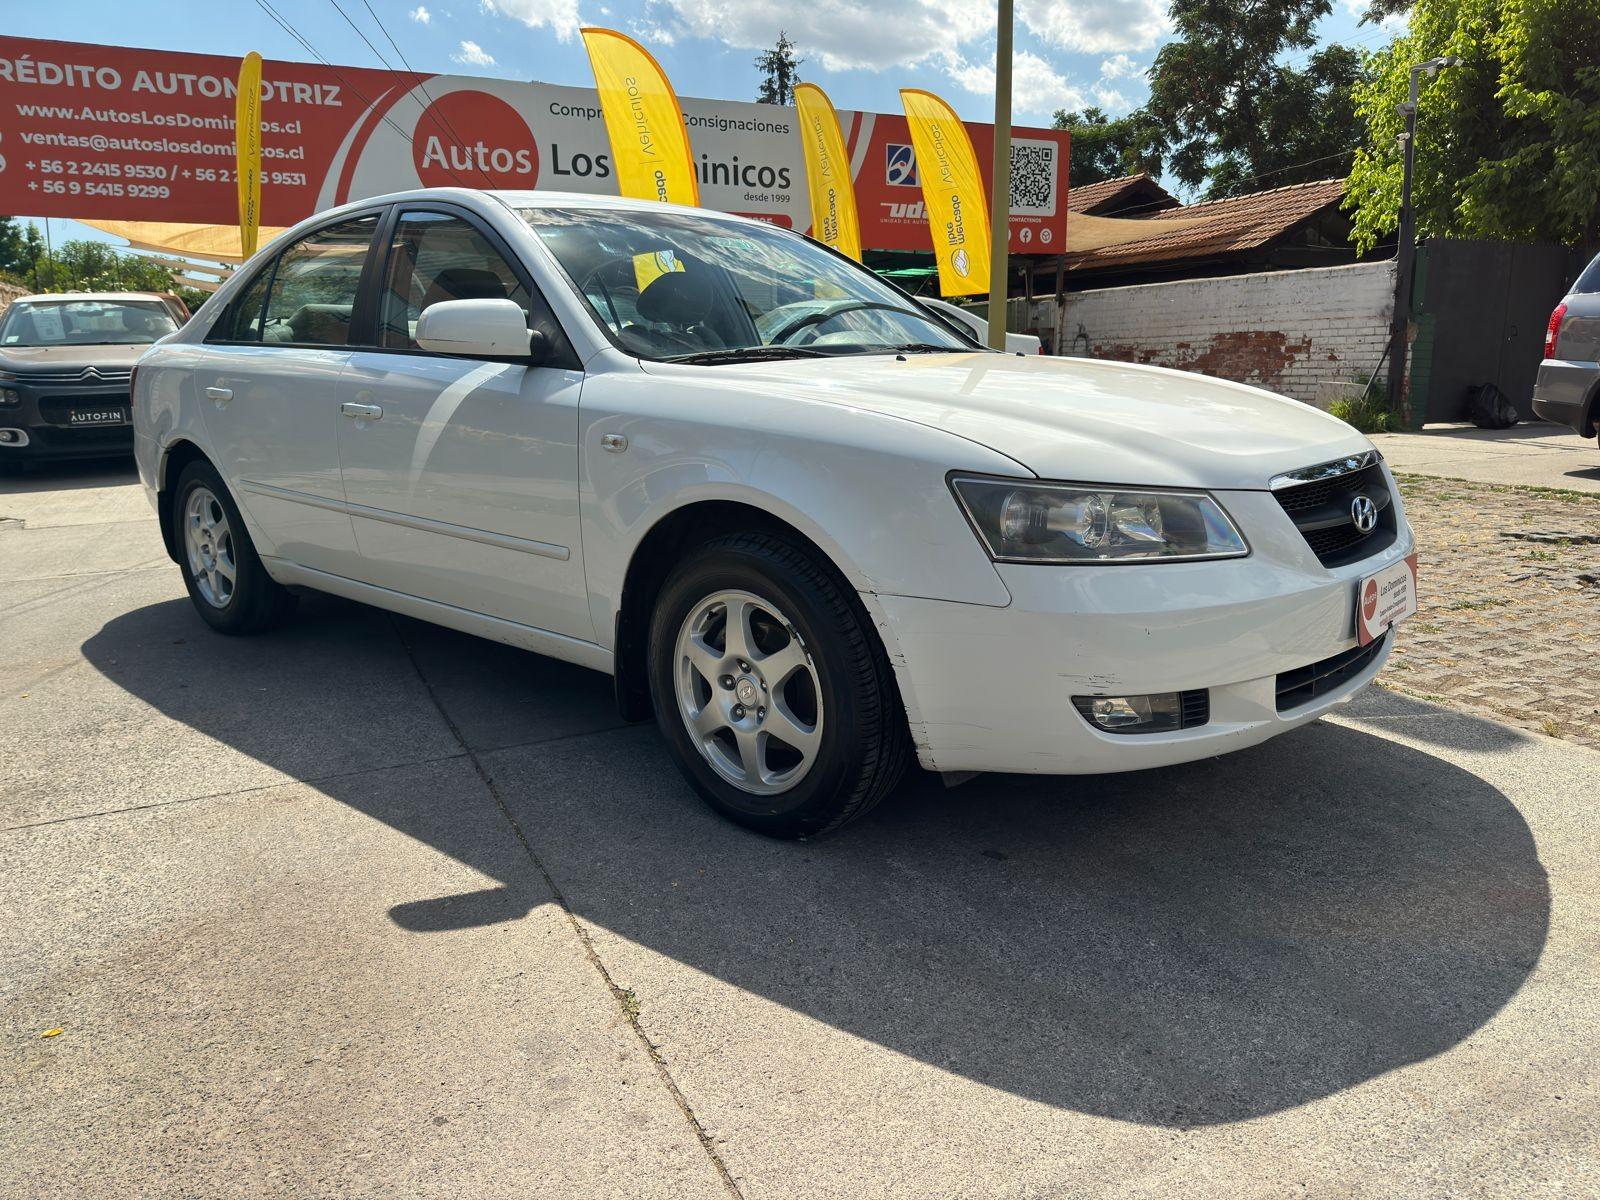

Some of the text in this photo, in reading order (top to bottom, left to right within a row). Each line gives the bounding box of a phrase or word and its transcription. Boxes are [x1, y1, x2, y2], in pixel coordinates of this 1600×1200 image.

[0, 54, 122, 90] RÉDITO
[549, 102, 604, 120] Compr
[422, 135, 532, 174] Autos
[40, 159, 64, 174] 56
[66, 161, 79, 175] 2
[81, 161, 121, 177] 2415
[124, 164, 167, 179] 9530
[170, 164, 178, 181] /
[195, 168, 217, 182] 56
[219, 169, 230, 182] 2
[271, 172, 307, 185] 9531
[552, 143, 791, 189] Los inicos
[43, 180, 66, 194] 56
[68, 181, 81, 195] 9
[85, 182, 124, 197] 5415
[127, 184, 170, 199] 9299
[744, 192, 791, 203] desde 1999
[71, 411, 121, 422] AUTOFIN
